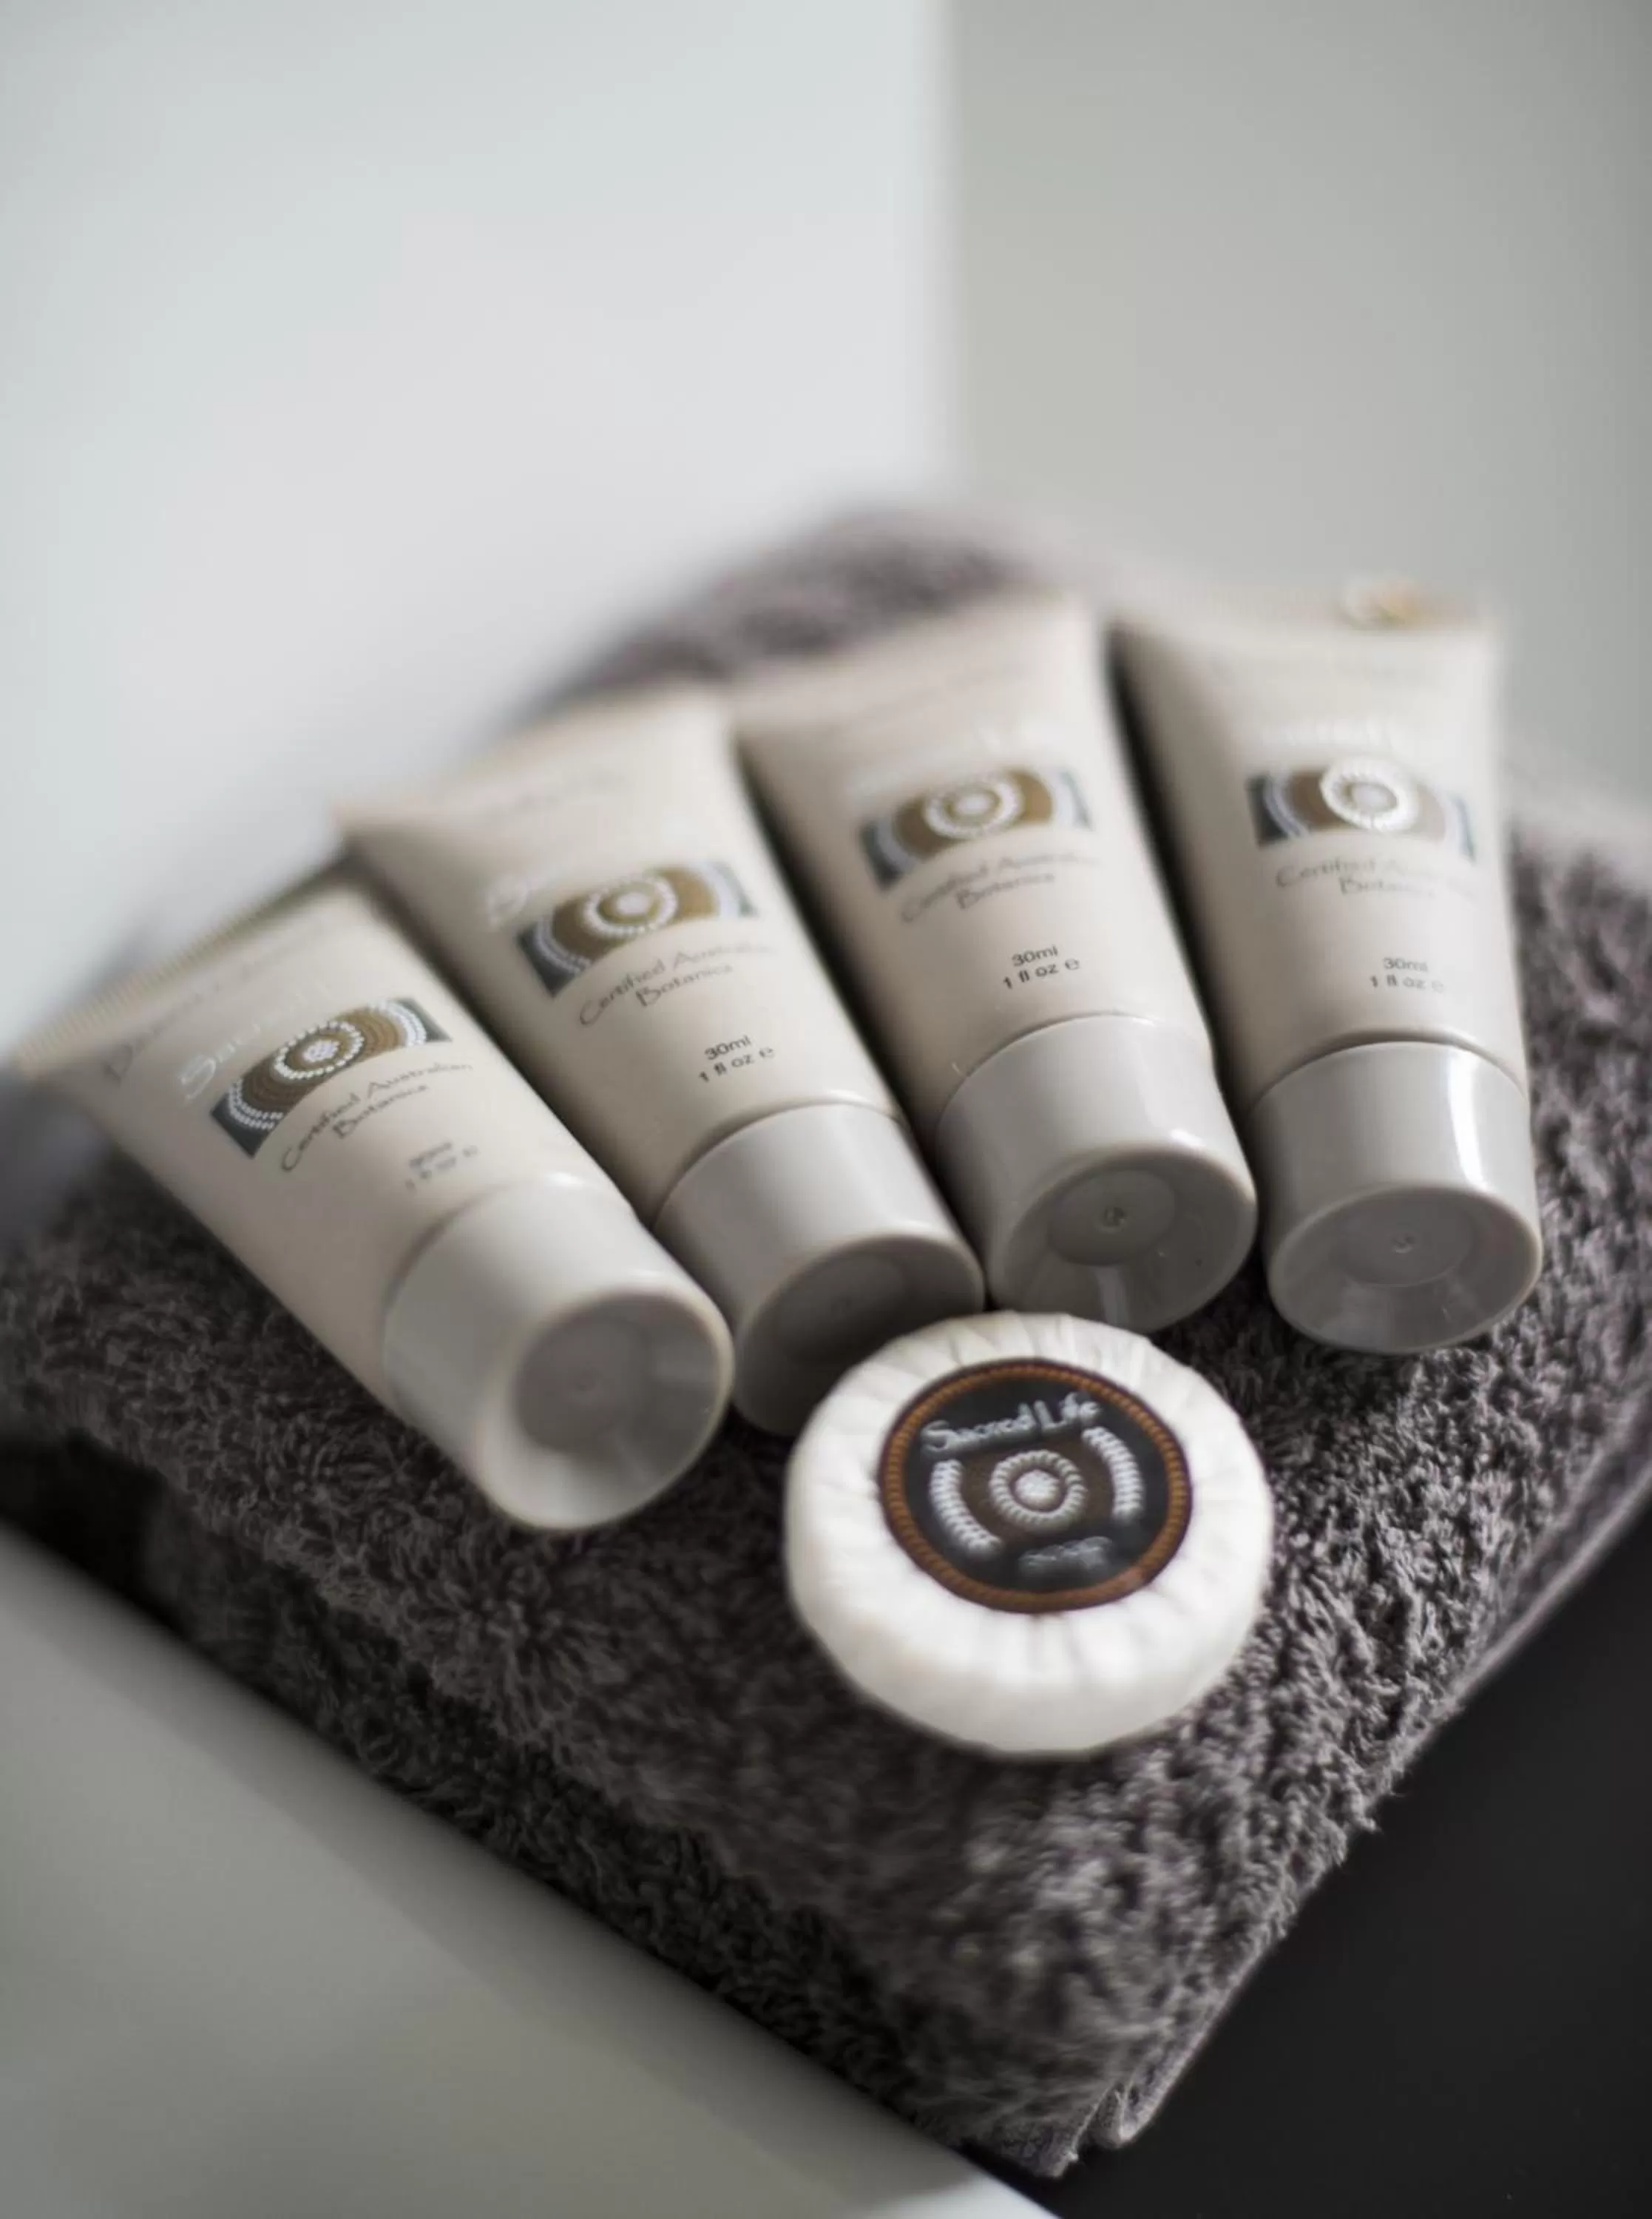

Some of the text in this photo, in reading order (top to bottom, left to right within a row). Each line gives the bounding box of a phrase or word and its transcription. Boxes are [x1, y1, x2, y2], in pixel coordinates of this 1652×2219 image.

[1011, 944, 1060, 967] 30ml
[1003, 976, 1013, 990] 1
[1018, 969, 1031, 984] fl
[1035, 963, 1059, 979] oz
[704, 1033, 753, 1061] 30ml
[698, 1070, 710, 1084] 1
[731, 1053, 756, 1069] oz
